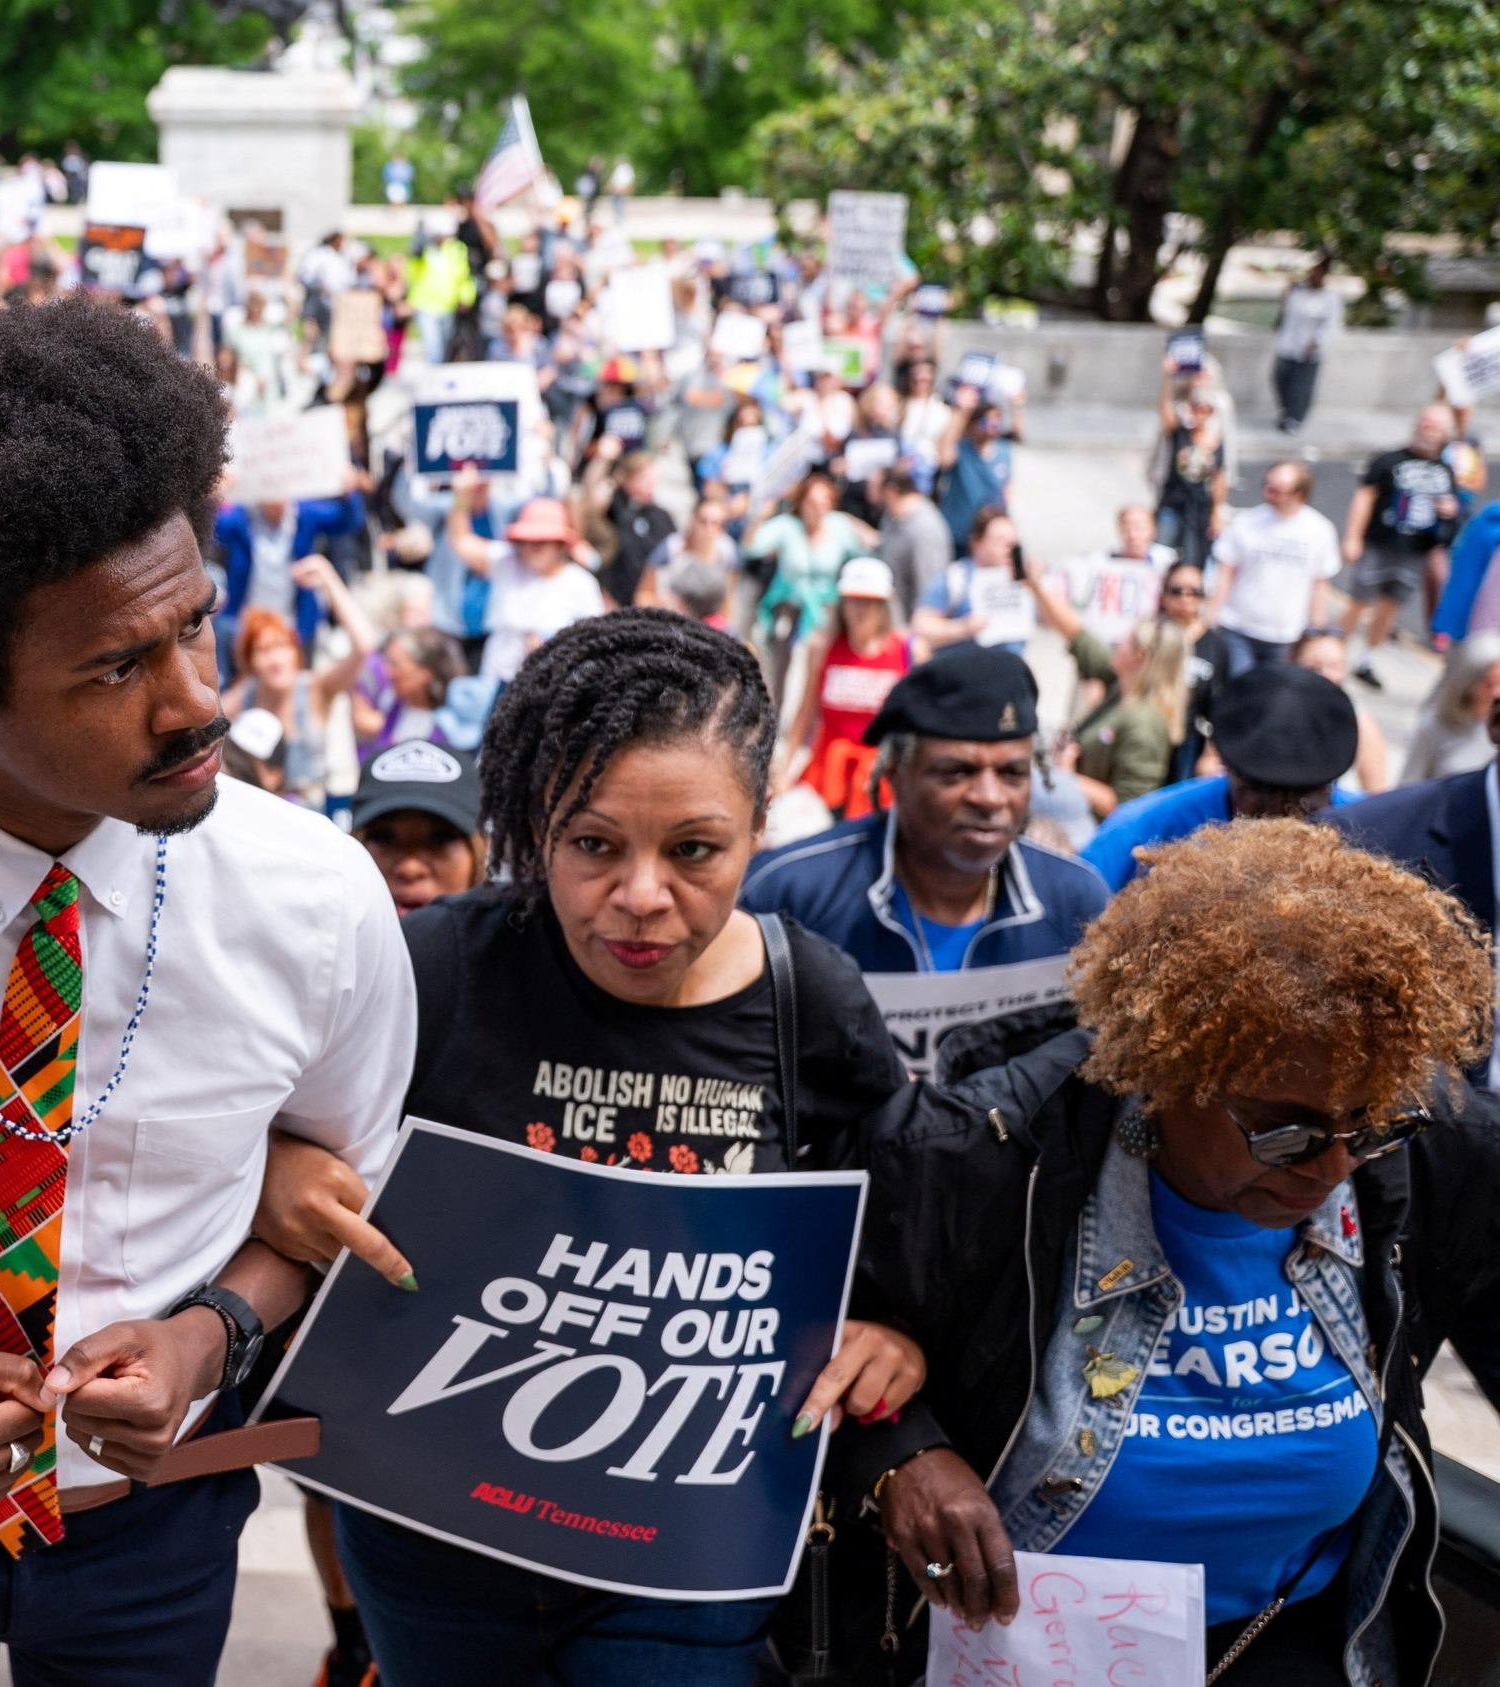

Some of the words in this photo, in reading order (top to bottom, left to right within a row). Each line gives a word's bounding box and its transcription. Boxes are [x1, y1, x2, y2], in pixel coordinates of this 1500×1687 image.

[884, 1001, 987, 1020] PROTECT
[533, 1060, 654, 1109] ABOLISH
[659, 1073, 691, 1105] NO
[693, 1077, 765, 1112] HUMAN
[562, 1101, 618, 1143] ICE
[655, 1105, 678, 1133] IS
[681, 1105, 761, 1138] ILLEGAL
[536, 1233, 775, 1301] HANDS
[480, 1276, 650, 1346] OFF
[660, 1307, 780, 1358] OUR
[386, 1315, 786, 1486] VOTE
[1165, 1390, 1369, 1440] CONGRESSMA
[470, 1481, 535, 1514] ACLU
[537, 1500, 658, 1542] Tennessee
